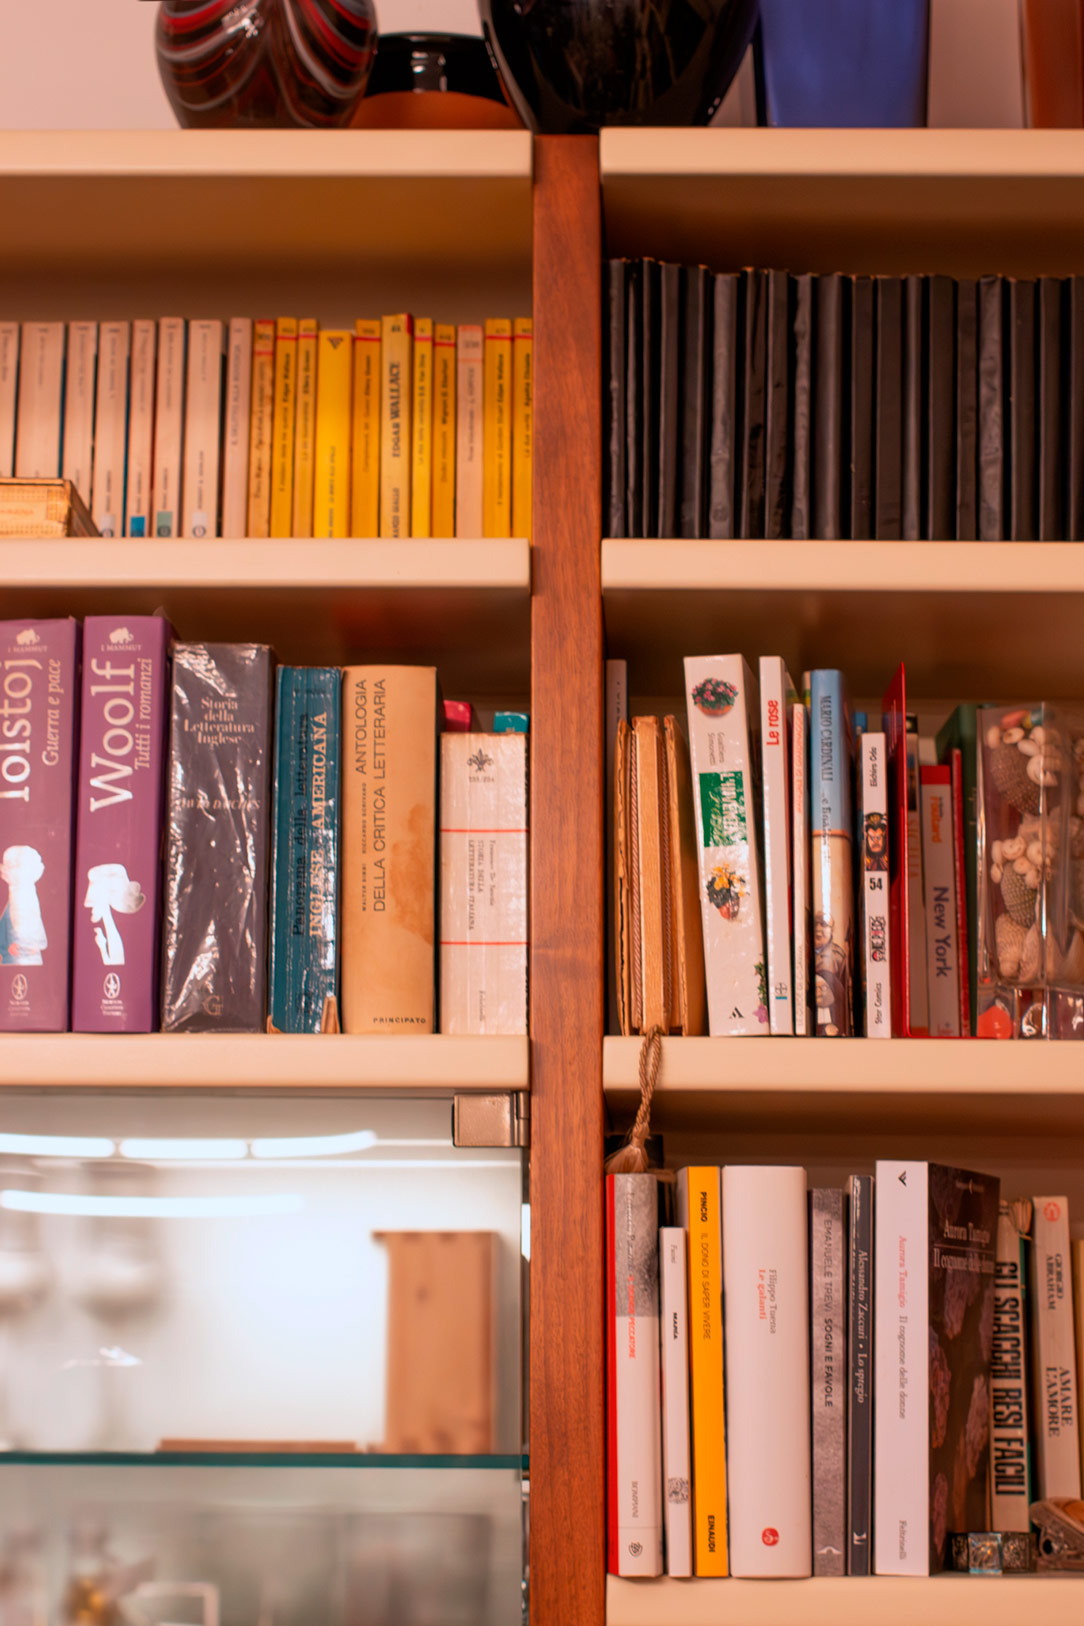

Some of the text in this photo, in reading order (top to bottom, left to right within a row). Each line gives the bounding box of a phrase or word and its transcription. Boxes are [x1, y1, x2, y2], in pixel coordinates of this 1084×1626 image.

[389, 361, 401, 458] EDGAR WALLACE
[42, 658, 64, 766] Guerra e pace
[137, 657, 152, 720] romanzi
[201, 696, 238, 710] Storia
[820, 695, 833, 726] MARIO
[89, 657, 135, 813] Woolf
[184, 719, 255, 733] Letteratura
[197, 732, 242, 747] Inglese
[204, 709, 234, 722] della
[355, 680, 367, 775] ANTOLOGIA
[766, 700, 780, 746] Le rose
[134, 733, 150, 770] Tutti
[820, 729, 833, 782] CARDINALI
[373, 679, 386, 912] DELLA CRITICA LETTERARIA
[292, 713, 308, 936] Panorama della letteratura
[310, 712, 326, 936] INGLESE AMERICANA
[869, 877, 883, 890] 54
[933, 887, 952, 977] New York
[373, 1016, 426, 1024] PRINCIPATO
[874, 983, 882, 1008] Comics
[700, 1191, 711, 1340] PINCIO IL DONO DI SAPER VIVERE
[823, 1219, 833, 1278] EMANUELE
[757, 1269, 767, 1320] Le galanti
[767, 1269, 777, 1302] Filippo
[823, 1281, 833, 1312] TREVI
[1045, 1254, 1057, 1310] ABRAHAM
[1054, 1253, 1064, 1299] GIORGIO
[628, 1317, 636, 1359] PECCATORE
[824, 1318, 833, 1352] SOGNI
[854, 1249, 868, 1404] Alessandro Zaccuri Lo spregio
[897, 1235, 908, 1419] Aurora Tamigio Il cognome delle donne
[992, 1297, 1021, 1380] SCACCHI
[824, 1365, 833, 1407] FAVOLE
[993, 1387, 1023, 1429] RESI
[1045, 1366, 1061, 1438] L'AMORE
[1058, 1366, 1073, 1427] AMARE
[994, 1438, 1025, 1496] FACILI
[707, 1515, 716, 1553] EINAUDI
